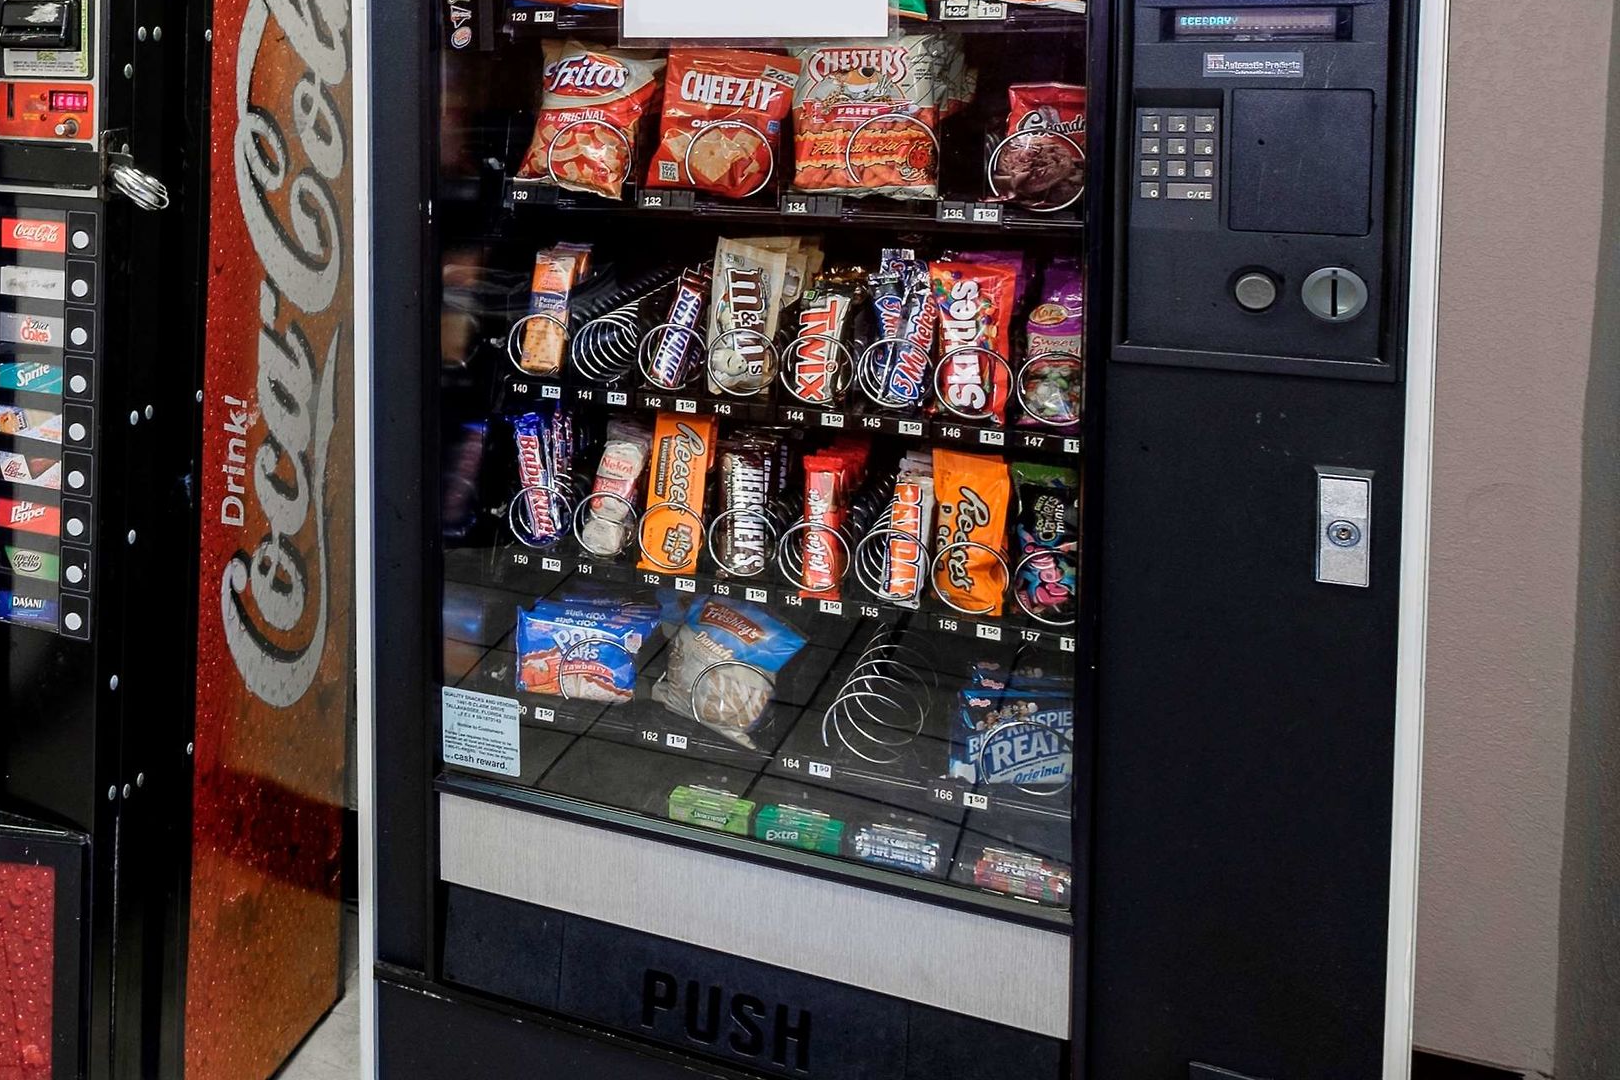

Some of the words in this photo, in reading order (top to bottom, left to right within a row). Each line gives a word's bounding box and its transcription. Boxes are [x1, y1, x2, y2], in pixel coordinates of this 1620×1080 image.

[511, 12, 527, 22] 120
[945, 6, 967, 17] 126
[544, 54, 629, 92] Fritos
[837, 106, 879, 116] FRIES
[511, 190, 528, 200] 130
[1187, 190, 1212, 200] C/CE
[644, 196, 662, 207] 132
[787, 202, 806, 213] 134
[942, 209, 964, 220] 136
[13, 222, 60, 243] Coca-Cola
[21, 326, 49, 343] Coke
[944, 279, 987, 410] SKITTLES
[1031, 336, 1075, 349] Sweet
[795, 299, 840, 401] TWIX
[16, 363, 51, 387] Sprite
[512, 383, 528, 394] 140
[892, 374, 914, 396] 3
[577, 390, 593, 400] 141
[645, 397, 662, 408] 142
[713, 404, 731, 415] 143
[786, 410, 805, 421] 144
[862, 417, 881, 429] 145
[941, 427, 961, 439] 146
[1023, 436, 1045, 448] 147
[220, 392, 250, 528] Drink!
[518, 434, 544, 490] Baby
[667, 422, 706, 517] Reese's
[20, 500, 34, 511] Dr
[10, 505, 47, 523] Pepper
[663, 527, 676, 554] SIZE
[675, 522, 694, 567] LARGE
[947, 485, 990, 594] Reese's
[513, 554, 529, 565] 150
[577, 564, 593, 574] 151
[643, 574, 660, 585] 152
[712, 584, 730, 595] 153
[12, 596, 43, 609] DASANI
[784, 595, 803, 606] 154
[860, 606, 879, 618] 155
[706, 606, 759, 640] Freshley's
[938, 619, 958, 631] 156
[1020, 629, 1041, 642] 157
[694, 630, 735, 660] Danish
[641, 731, 659, 742] 162
[453, 753, 475, 764] cash
[476, 757, 509, 771] reward.
[782, 758, 800, 770] 164
[1013, 762, 1066, 783] Original
[934, 788, 953, 801] 166
[765, 829, 799, 841] Extra
[642, 968, 812, 1073] PUSH
